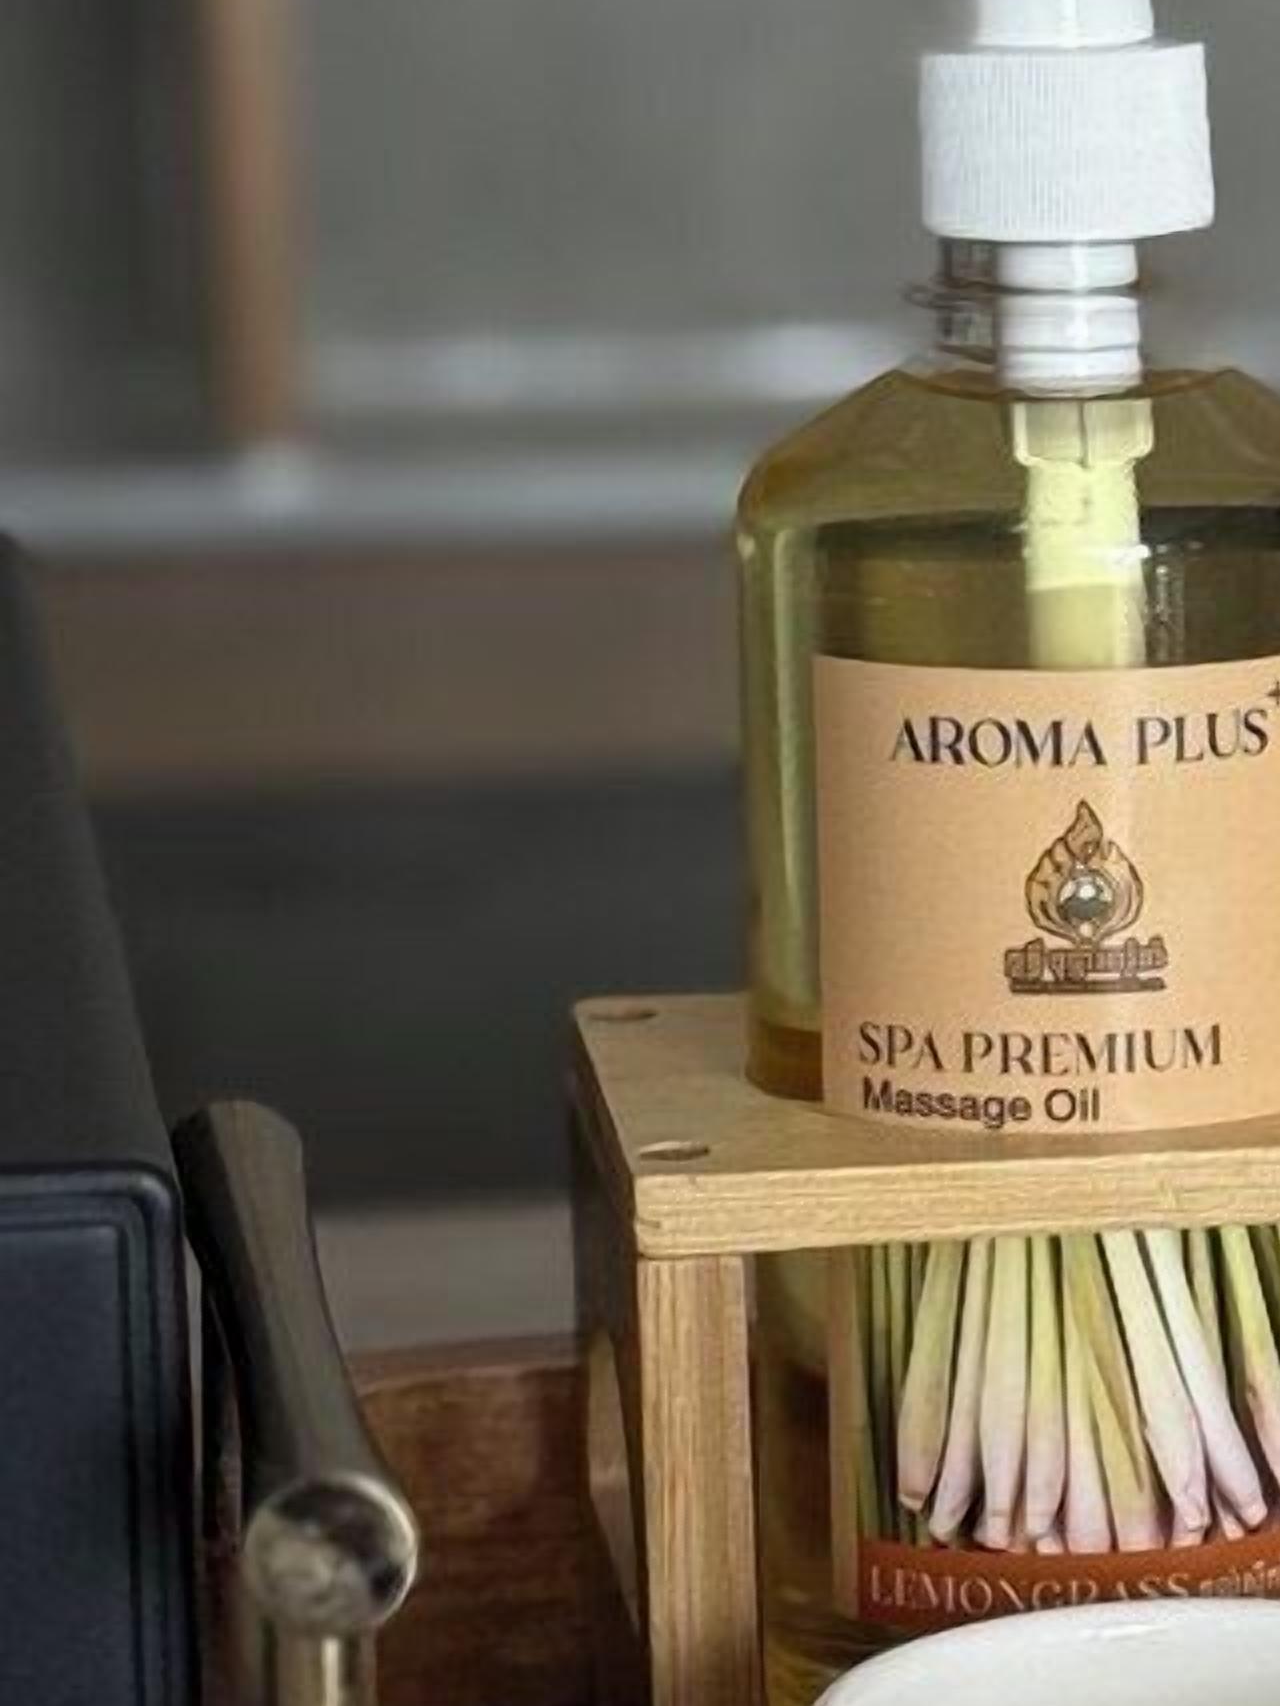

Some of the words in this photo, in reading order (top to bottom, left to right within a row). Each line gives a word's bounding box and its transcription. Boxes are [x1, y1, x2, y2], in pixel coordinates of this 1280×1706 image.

[889, 715, 1108, 769] AROMA
[857, 1021, 946, 1070] SPA
[961, 1024, 1223, 1076] PREMIUM
[861, 1076, 1033, 1130] Massage
[1044, 1087, 1101, 1123] Oil
